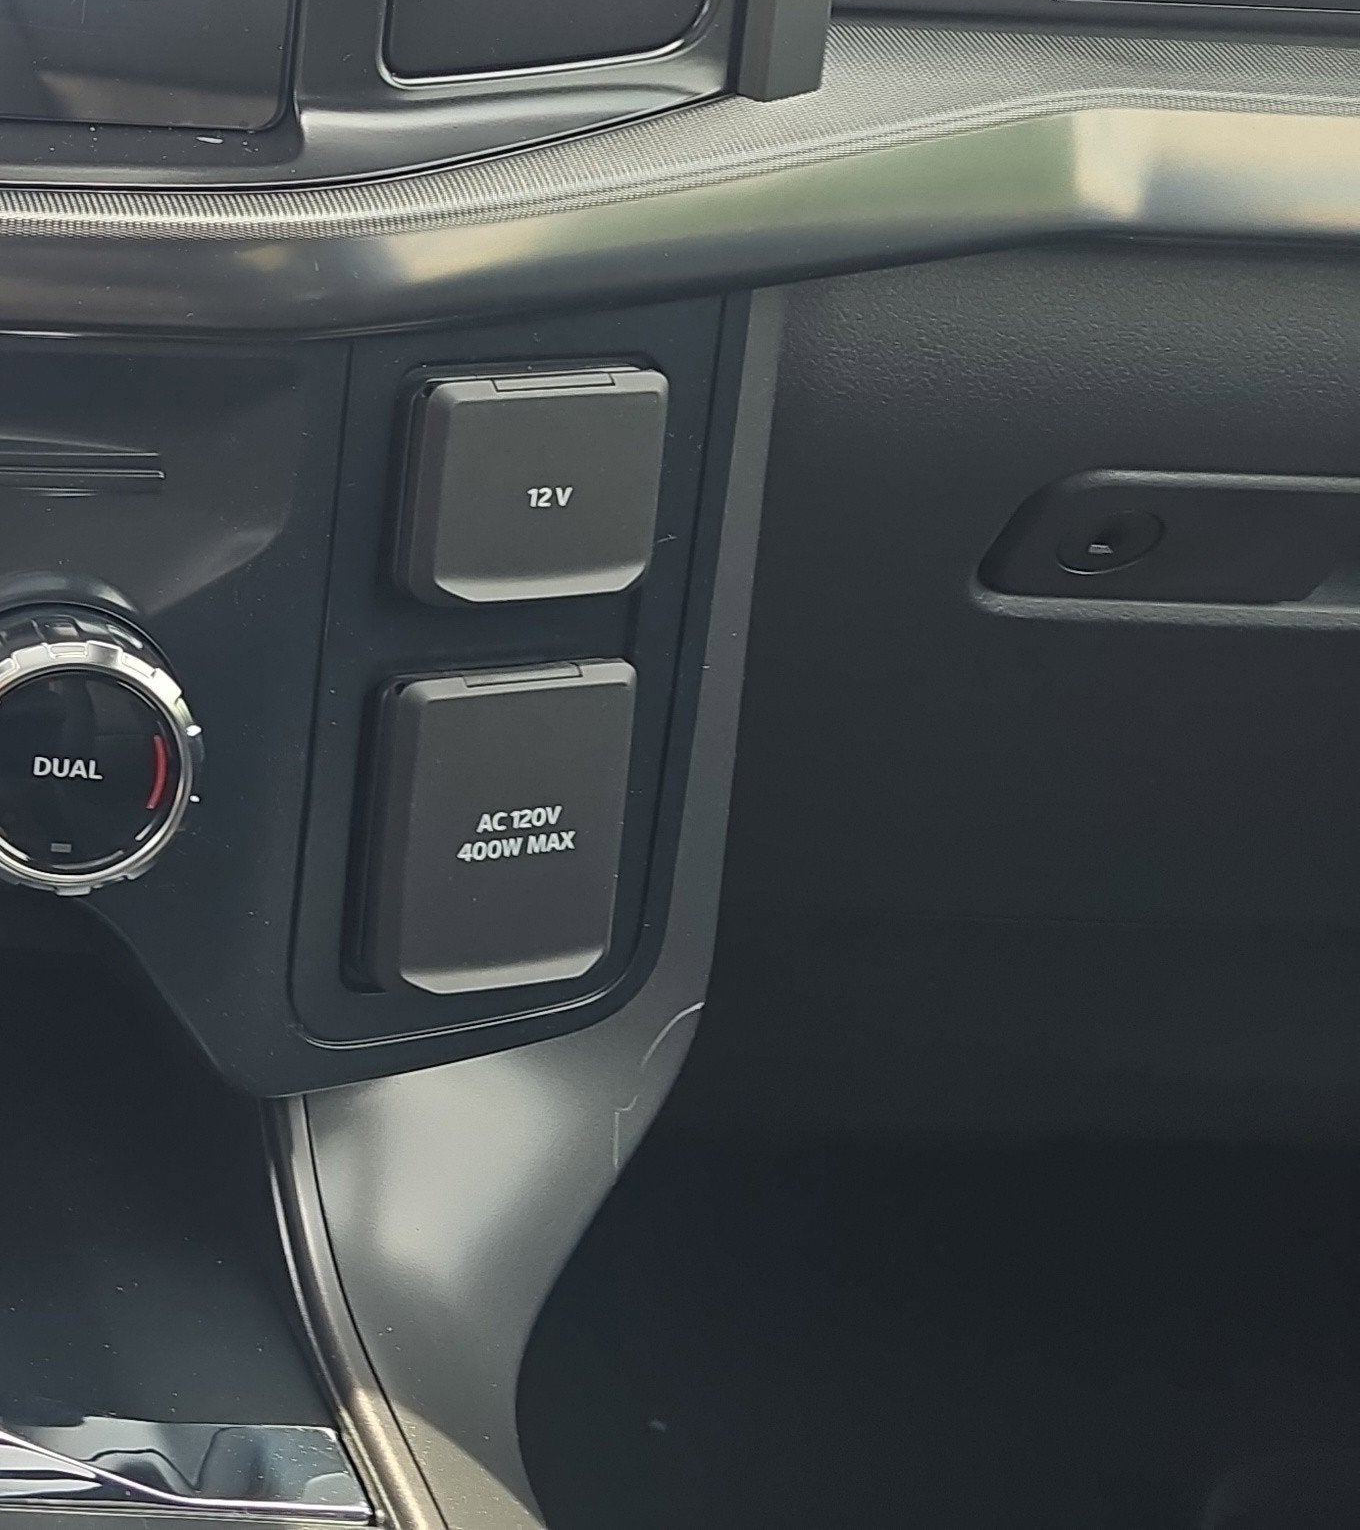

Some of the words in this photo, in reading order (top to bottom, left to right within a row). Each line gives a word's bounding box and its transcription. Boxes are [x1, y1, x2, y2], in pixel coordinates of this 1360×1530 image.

[32, 756, 103, 780] DUAL
[477, 810, 510, 833] AC
[511, 805, 562, 830] 120V
[457, 836, 523, 862] 400W
[527, 830, 576, 855] MAX
